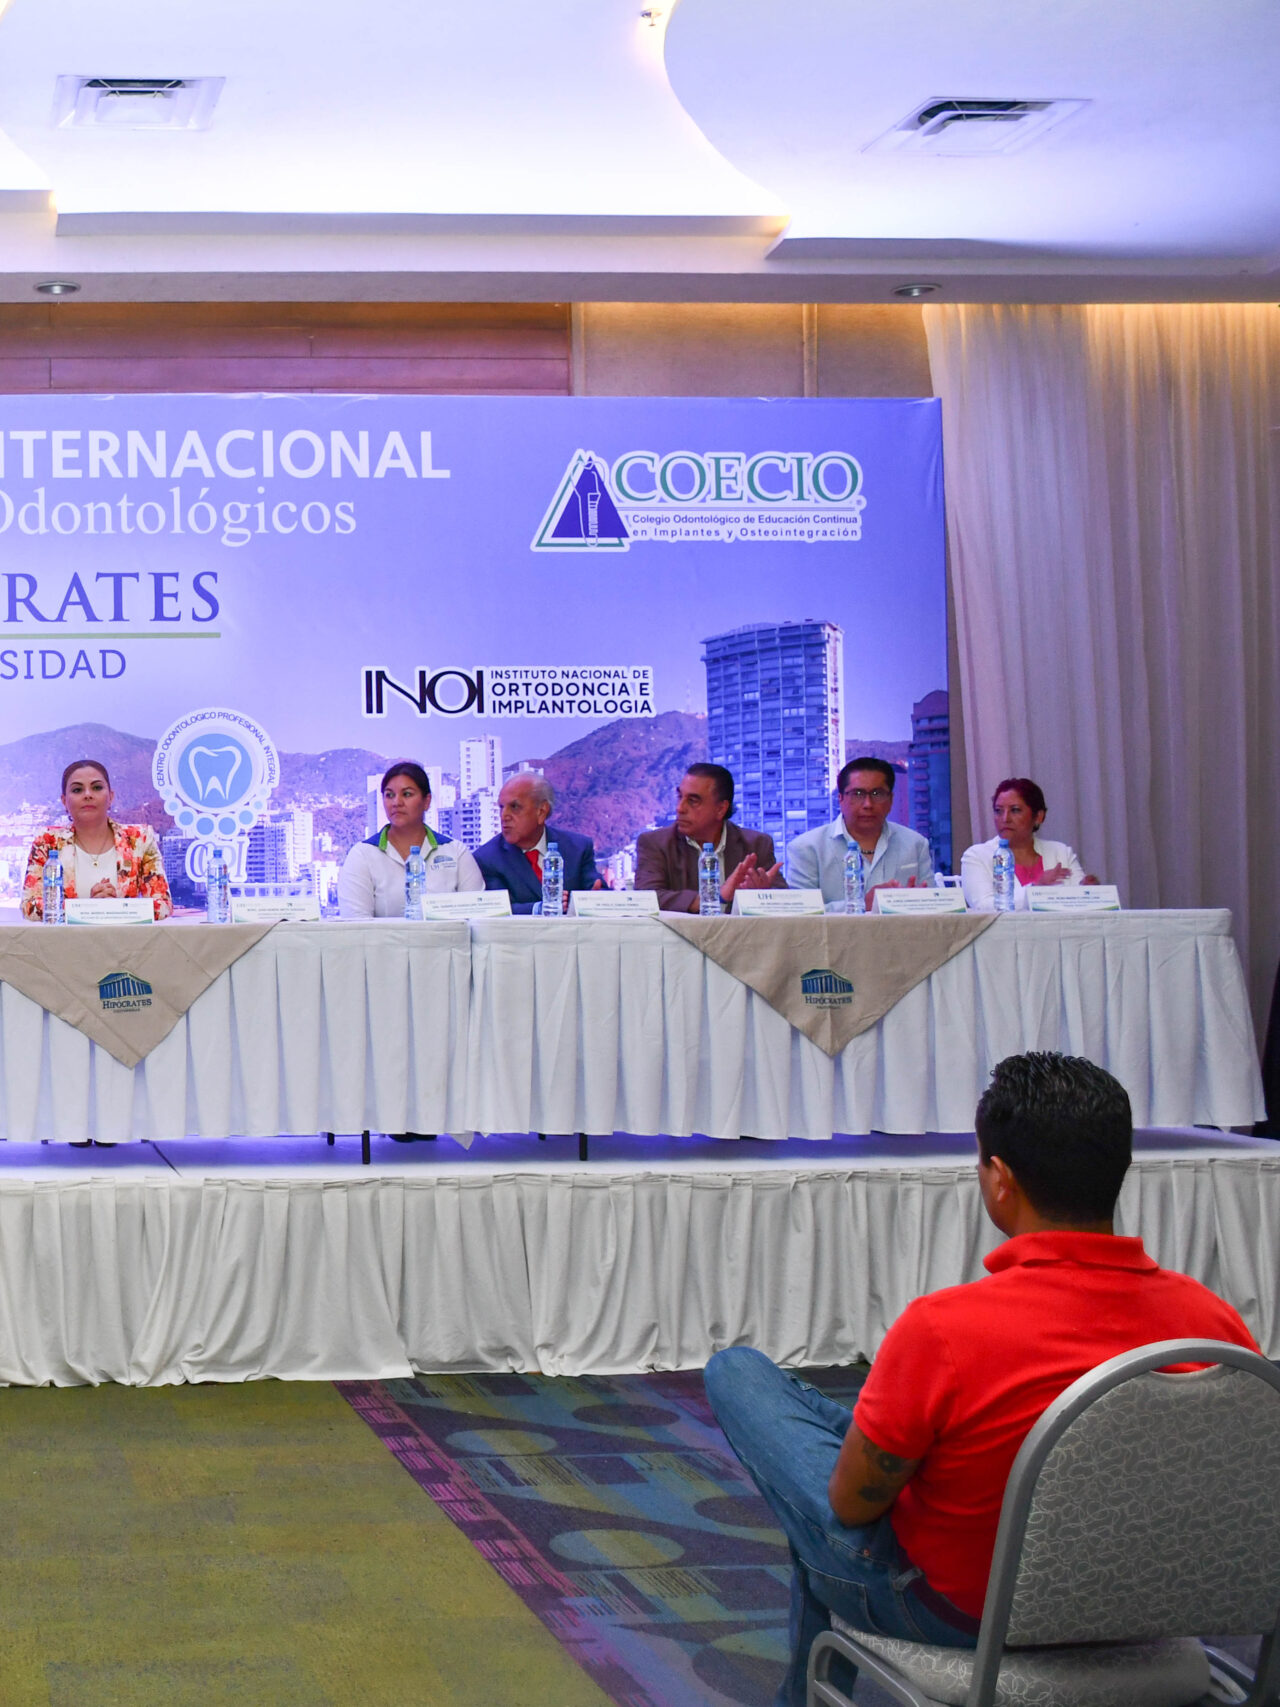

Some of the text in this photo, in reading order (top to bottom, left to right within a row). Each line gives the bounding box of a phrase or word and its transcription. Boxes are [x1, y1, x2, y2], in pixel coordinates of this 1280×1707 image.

[615, 455, 859, 502] COECIO
[632, 514, 671, 526] Colegio
[673, 513, 742, 526] Odontológico
[743, 514, 756, 525] de
[758, 514, 811, 525] Educación
[632, 527, 859, 540] en Implantes y Osteointegración
[490, 669, 650, 680] INSTITUTO NACIONAL DE
[491, 682, 650, 697] ORTODONCIA E
[492, 699, 653, 714] IMPLANTOLOGIA
[157, 711, 276, 787] CENTRO ODONTOLOGICO PROFESIONAL INTEGRAL
